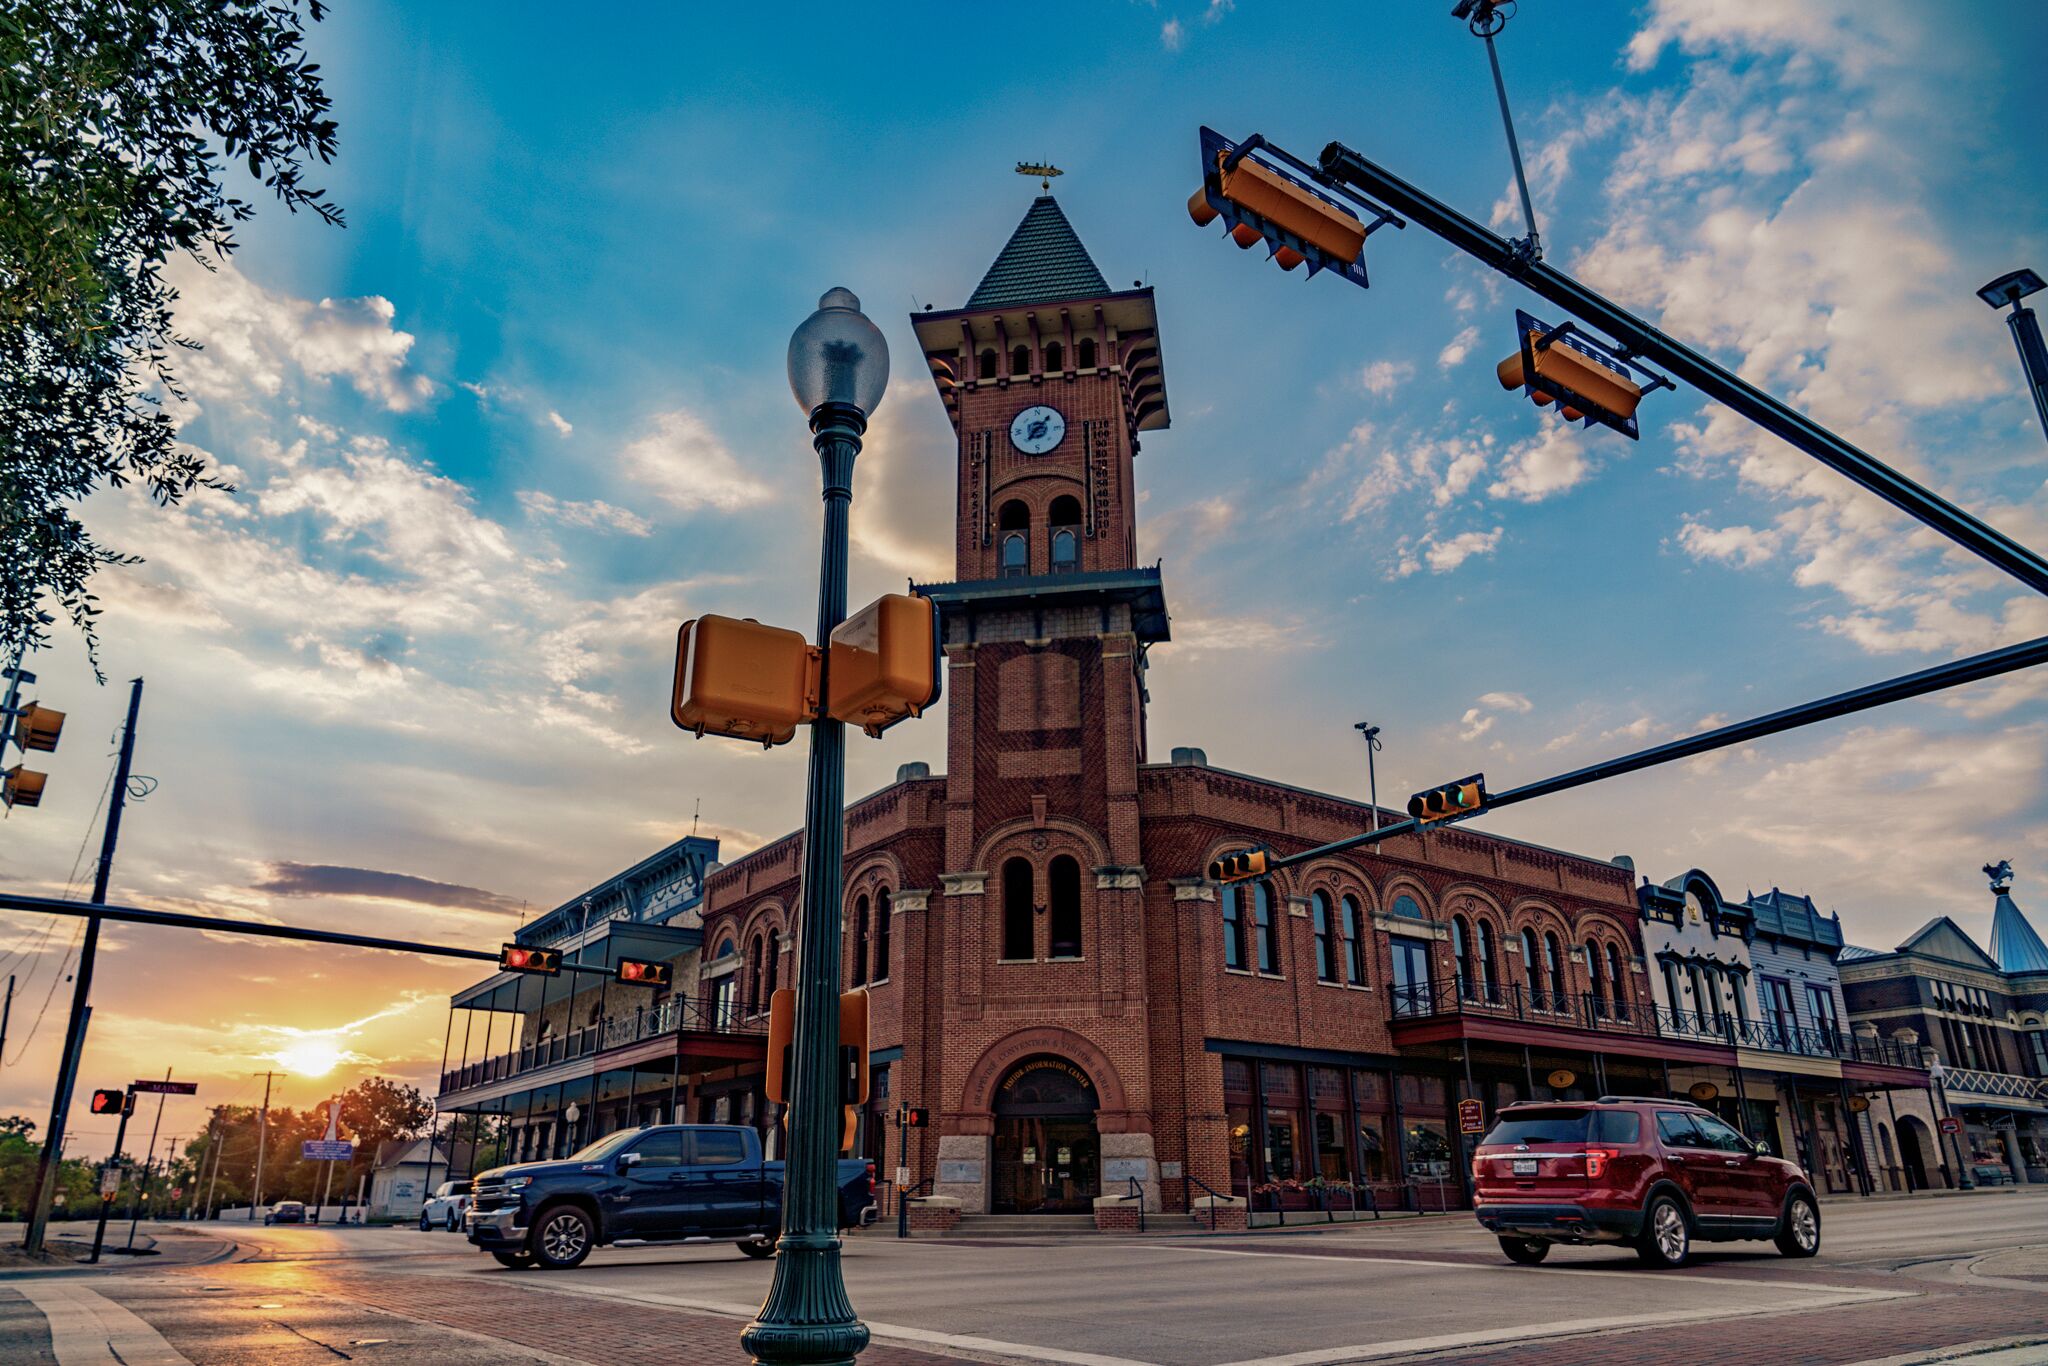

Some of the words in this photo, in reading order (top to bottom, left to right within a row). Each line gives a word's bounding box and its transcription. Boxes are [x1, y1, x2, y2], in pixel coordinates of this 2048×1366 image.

[1092, 421, 1109, 429] 110
[970, 432, 982, 441] 12
[1014, 428, 1022, 437] W
[1093, 430, 1110, 439] 100
[970, 451, 982, 460] 10
[1095, 449, 1108, 458] 80
[1095, 469, 1108, 478] 60
[972, 480, 979, 489] 7
[972, 491, 978, 499] 6
[1096, 489, 1109, 497] 40
[972, 501, 978, 509] 5
[1096, 499, 1109, 508] 30
[1096, 510, 1109, 518] 20
[1096, 520, 1109, 528] 10
[972, 531, 978, 540] 2
[1100, 530, 1107, 539] 0
[999, 1039, 1050, 1060] CONVENTION
[1095, 1068, 1113, 1103] BUREAU
[1003, 1069, 1025, 1089] VISITOR
[1024, 1060, 1067, 1073] INFORMATION
[1067, 1067, 1090, 1089] CENTER
[152, 1084, 179, 1093] MAIN
